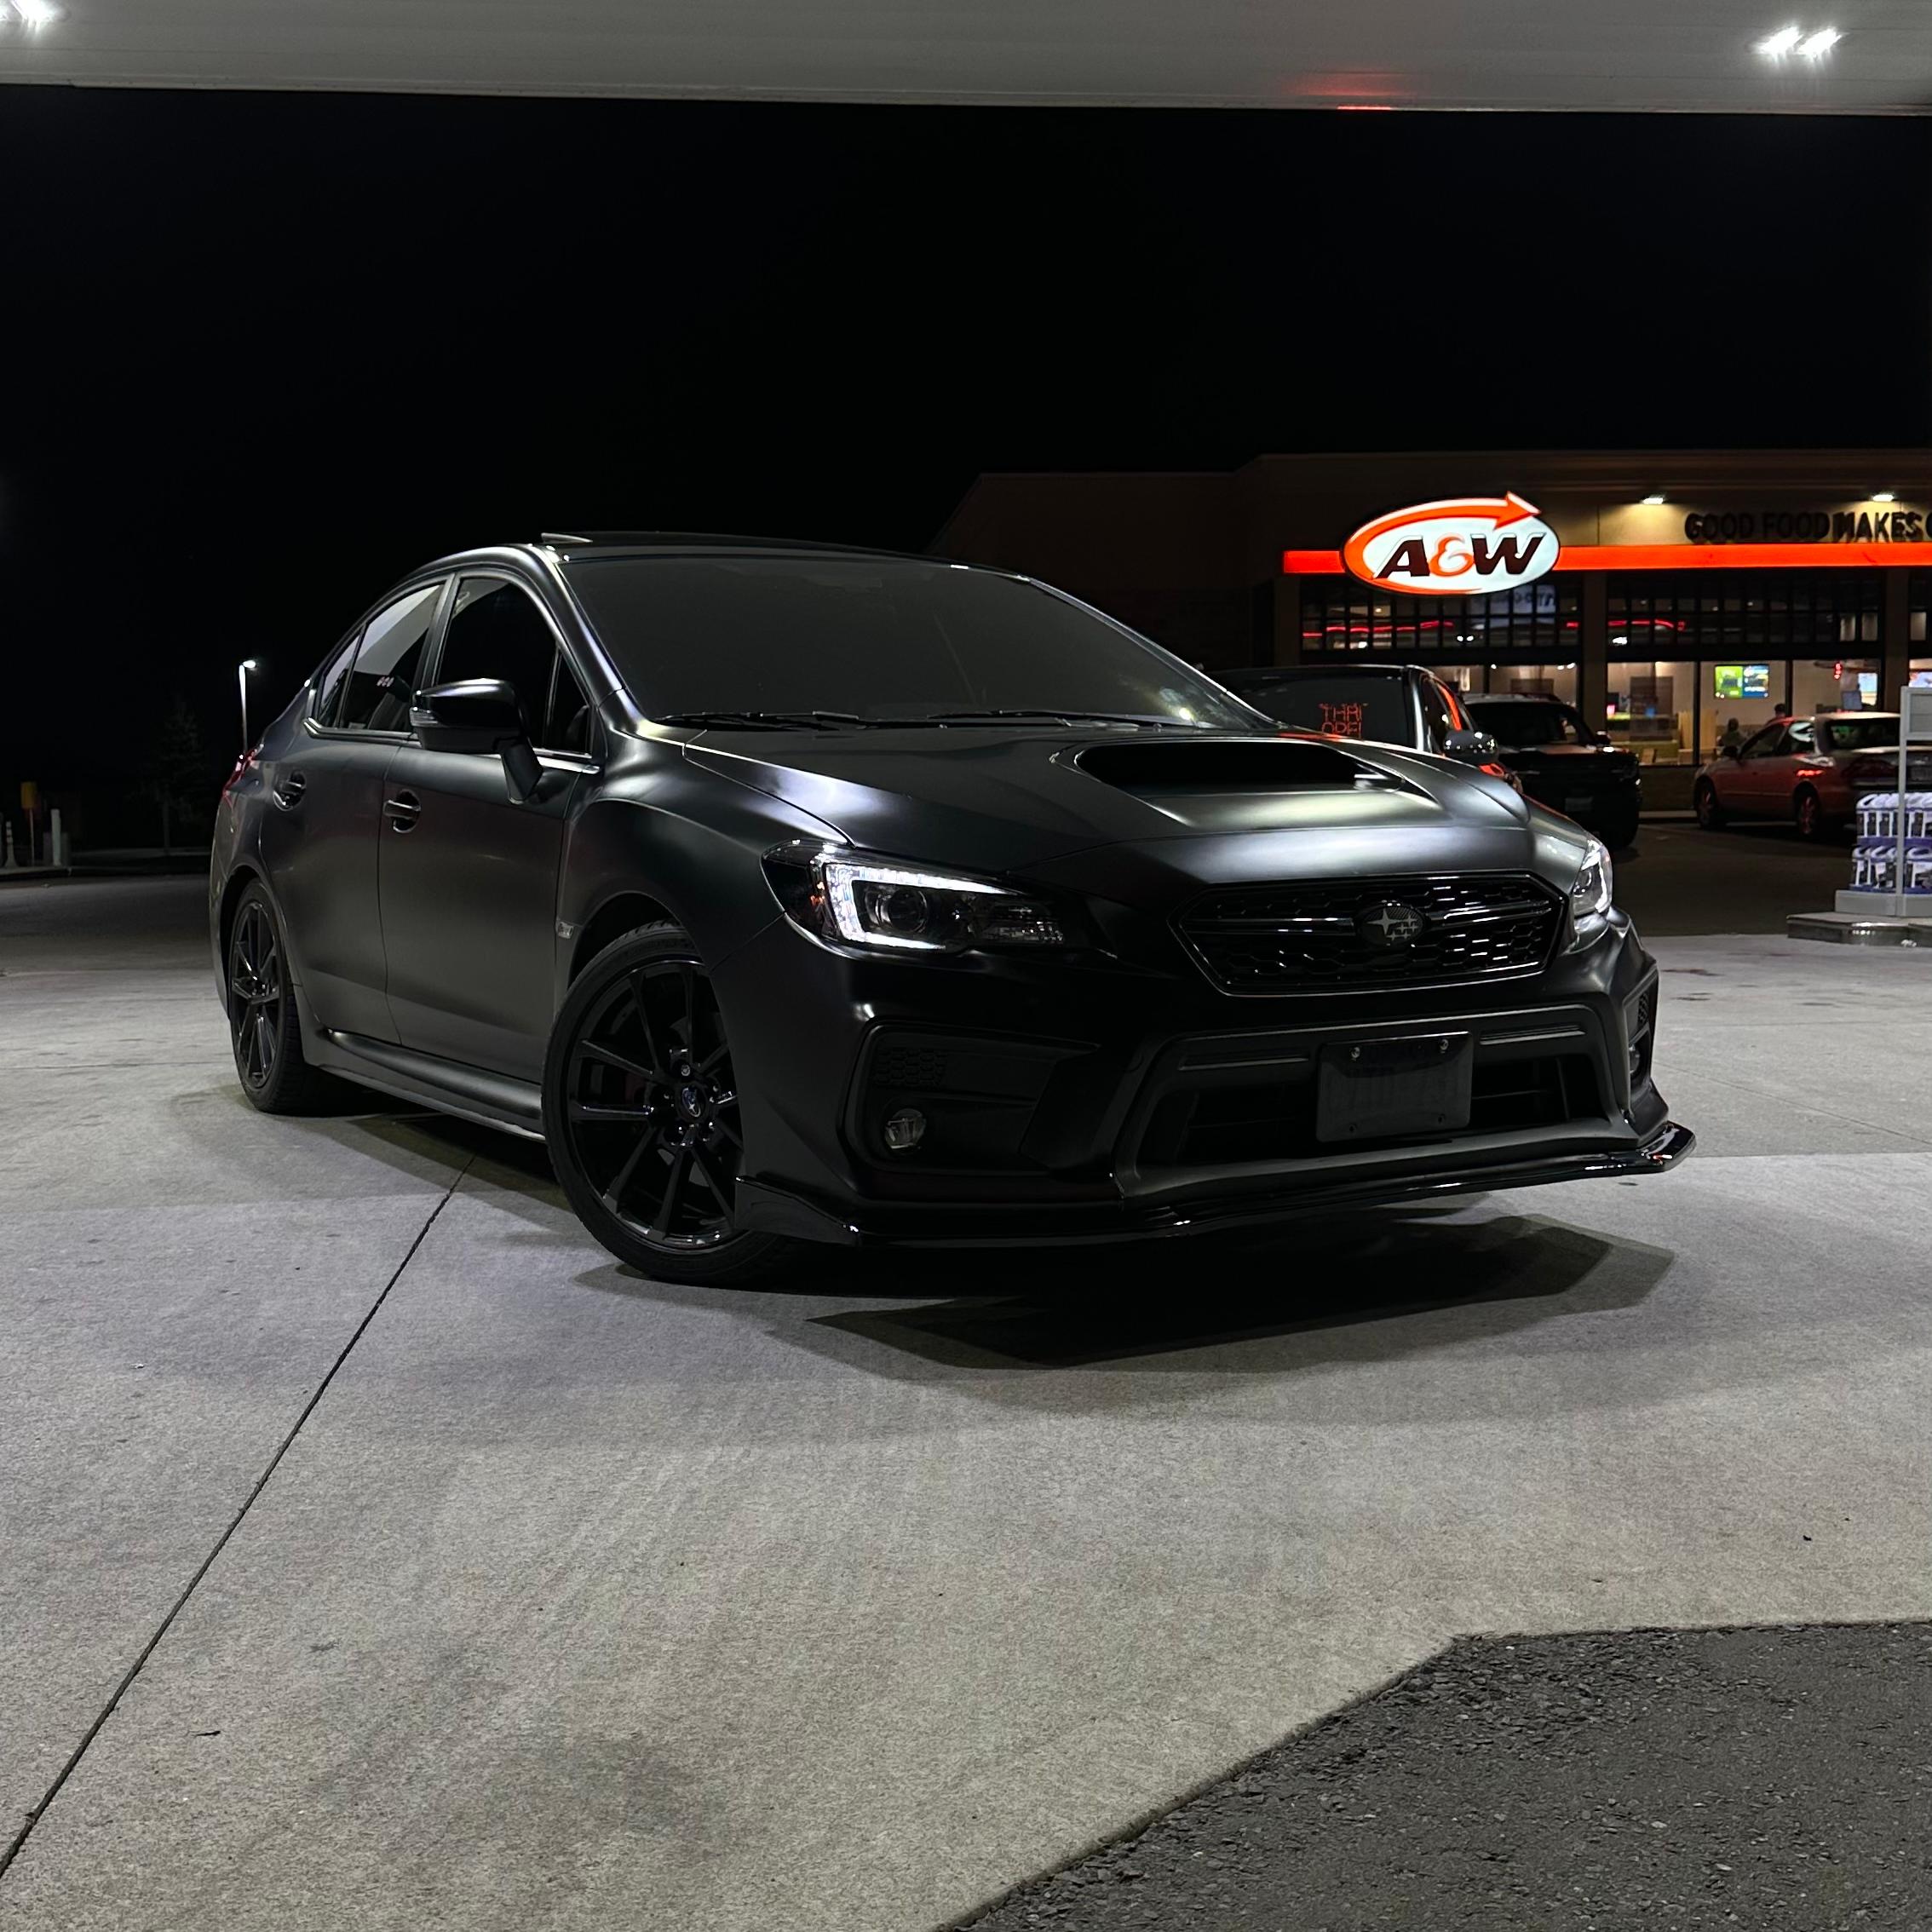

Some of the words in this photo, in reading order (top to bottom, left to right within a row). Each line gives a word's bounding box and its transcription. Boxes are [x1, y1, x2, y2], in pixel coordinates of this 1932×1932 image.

[1685, 513, 1754, 541] GOOD
[1762, 513, 1830, 540] FOOD
[1832, 512, 1923, 541] MAKES
[1373, 532, 1546, 579] A&W
